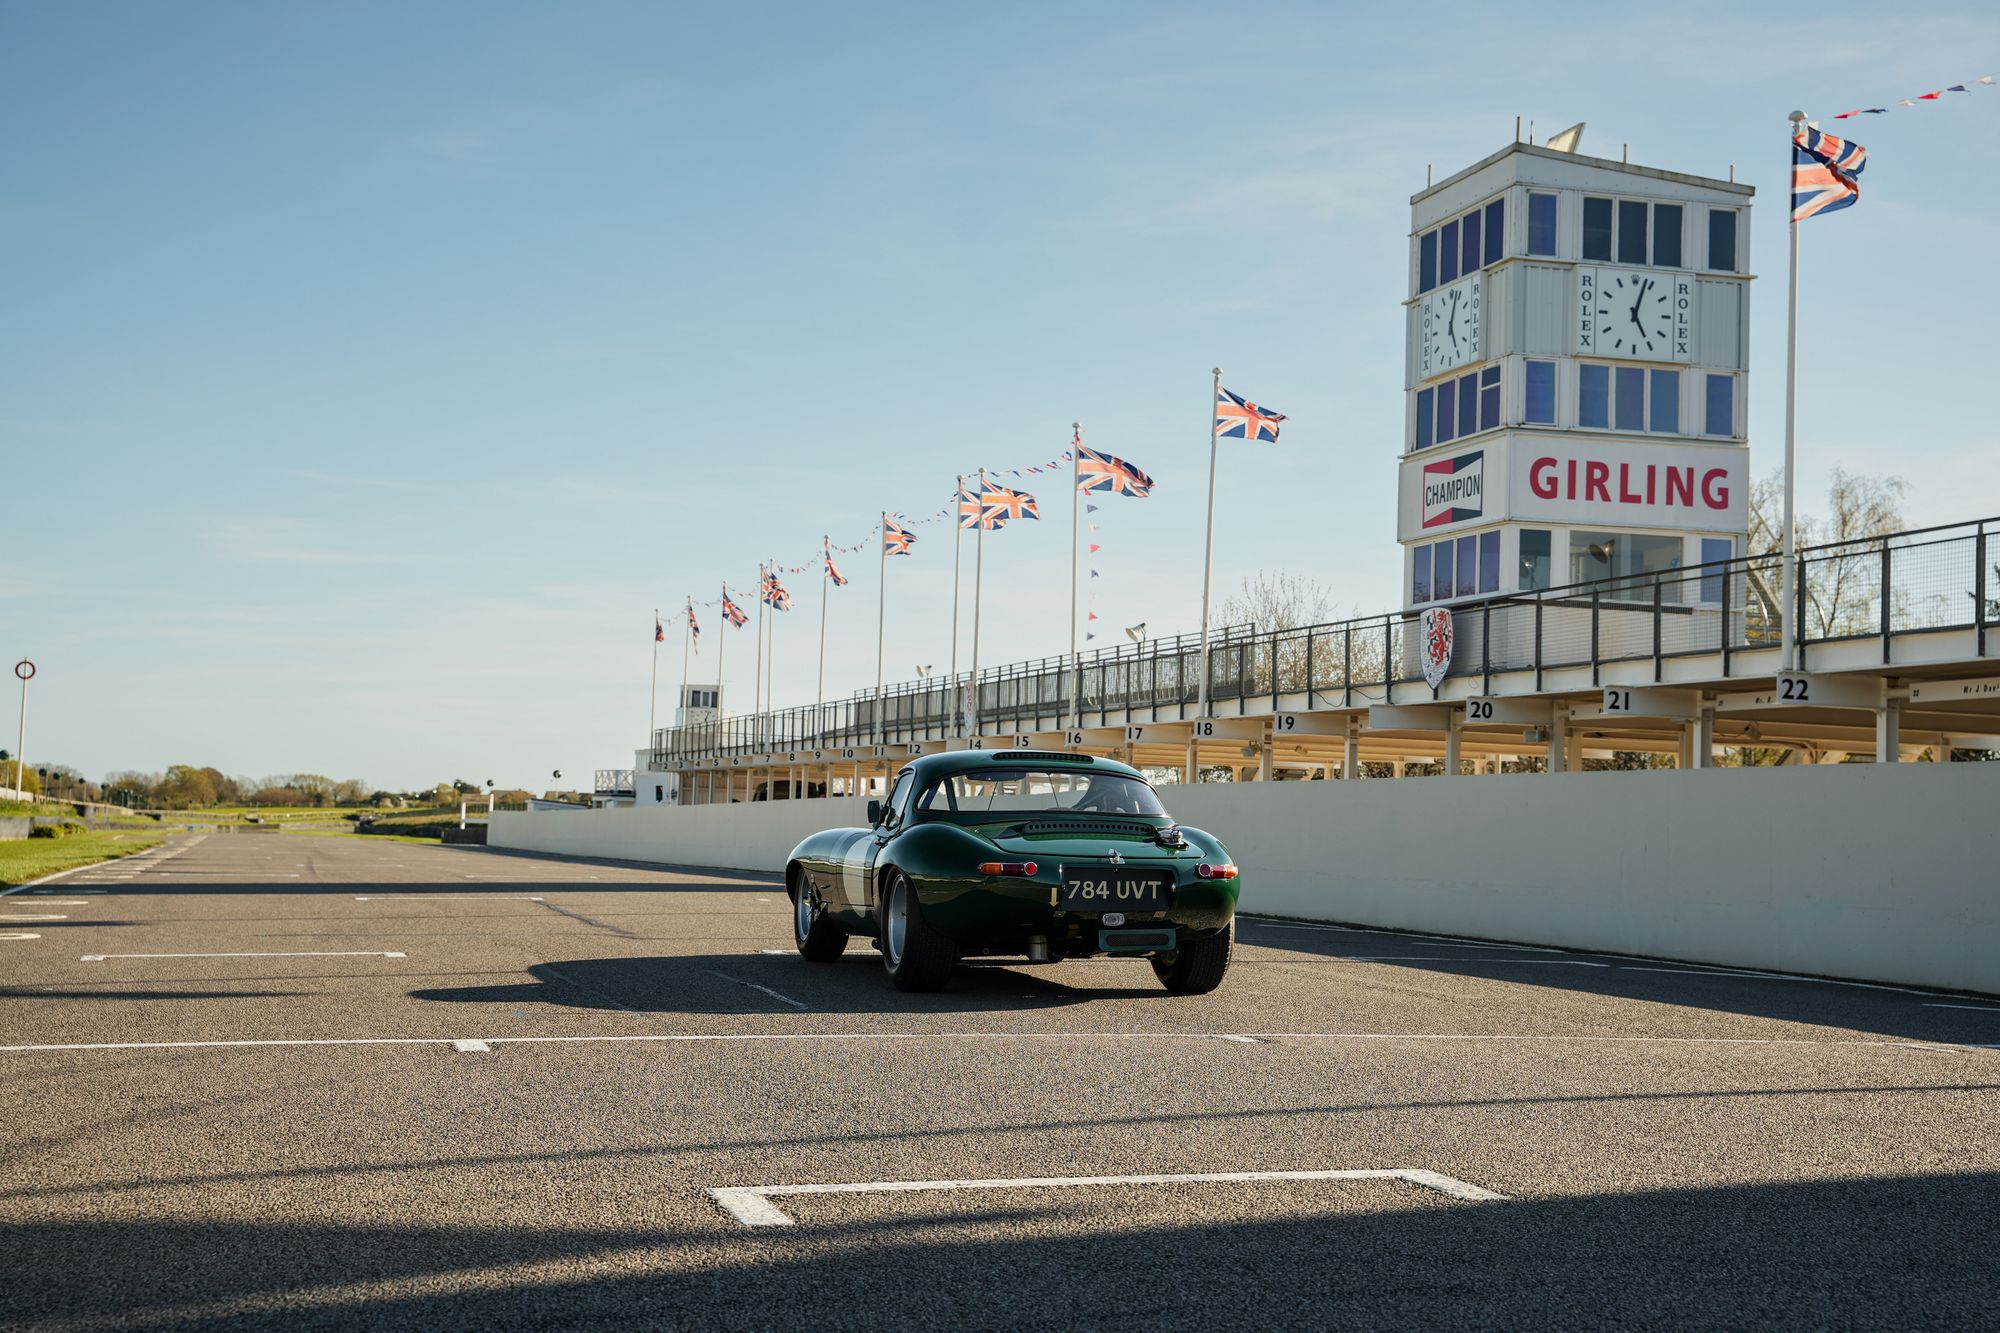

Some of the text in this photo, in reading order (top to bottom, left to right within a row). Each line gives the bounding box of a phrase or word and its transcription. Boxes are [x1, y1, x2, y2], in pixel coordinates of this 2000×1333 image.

[1580, 275, 1593, 346] ROLEX
[1677, 283, 1689, 354] ROLEX
[1423, 303, 1431, 371] ROLEX
[1529, 456, 1730, 510] GIRLING
[1425, 474, 1481, 507] CHAMPION
[1781, 678, 1809, 701] 22
[1608, 690, 1630, 711] 21
[1470, 701, 1493, 719] 20
[1278, 715, 1295, 730] 19
[1128, 727, 1143, 740] 17
[1197, 722, 1213, 736] 18
[1016, 735, 1029, 747] 15
[1068, 731, 1082, 744] 16
[908, 743, 921, 754] 12
[969, 739, 982, 750] 14
[789, 752, 796, 761] 8
[815, 750, 821, 760] 9
[842, 748, 854, 759] 10
[874, 746, 884, 757] 11
[695, 760, 701, 768] 4
[713, 758, 719, 767] 5
[733, 757, 739, 766] 6
[765, 754, 771, 763] 7
[663, 762, 669, 770] 2
[678, 761, 684, 769] 3
[1068, 880, 1162, 900] 784 UVT
